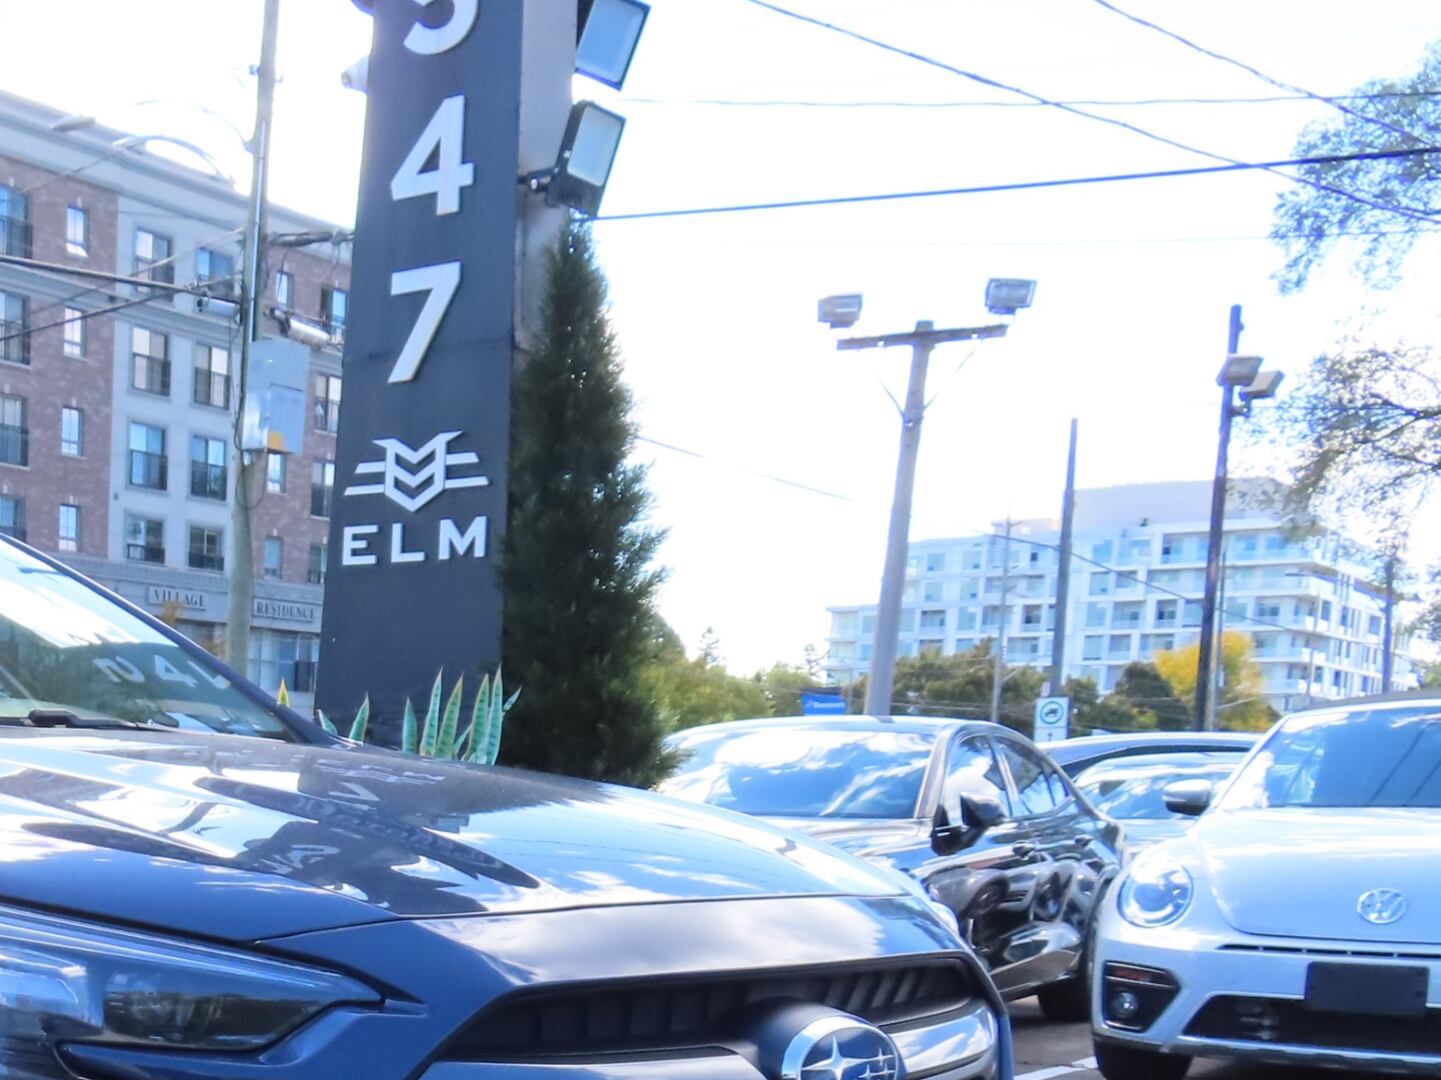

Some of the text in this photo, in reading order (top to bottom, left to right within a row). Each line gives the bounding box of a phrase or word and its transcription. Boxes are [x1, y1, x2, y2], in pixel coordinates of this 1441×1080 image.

[342, 515, 488, 566] ELM
[154, 588, 315, 620] VILLAGE RESIDENCE
